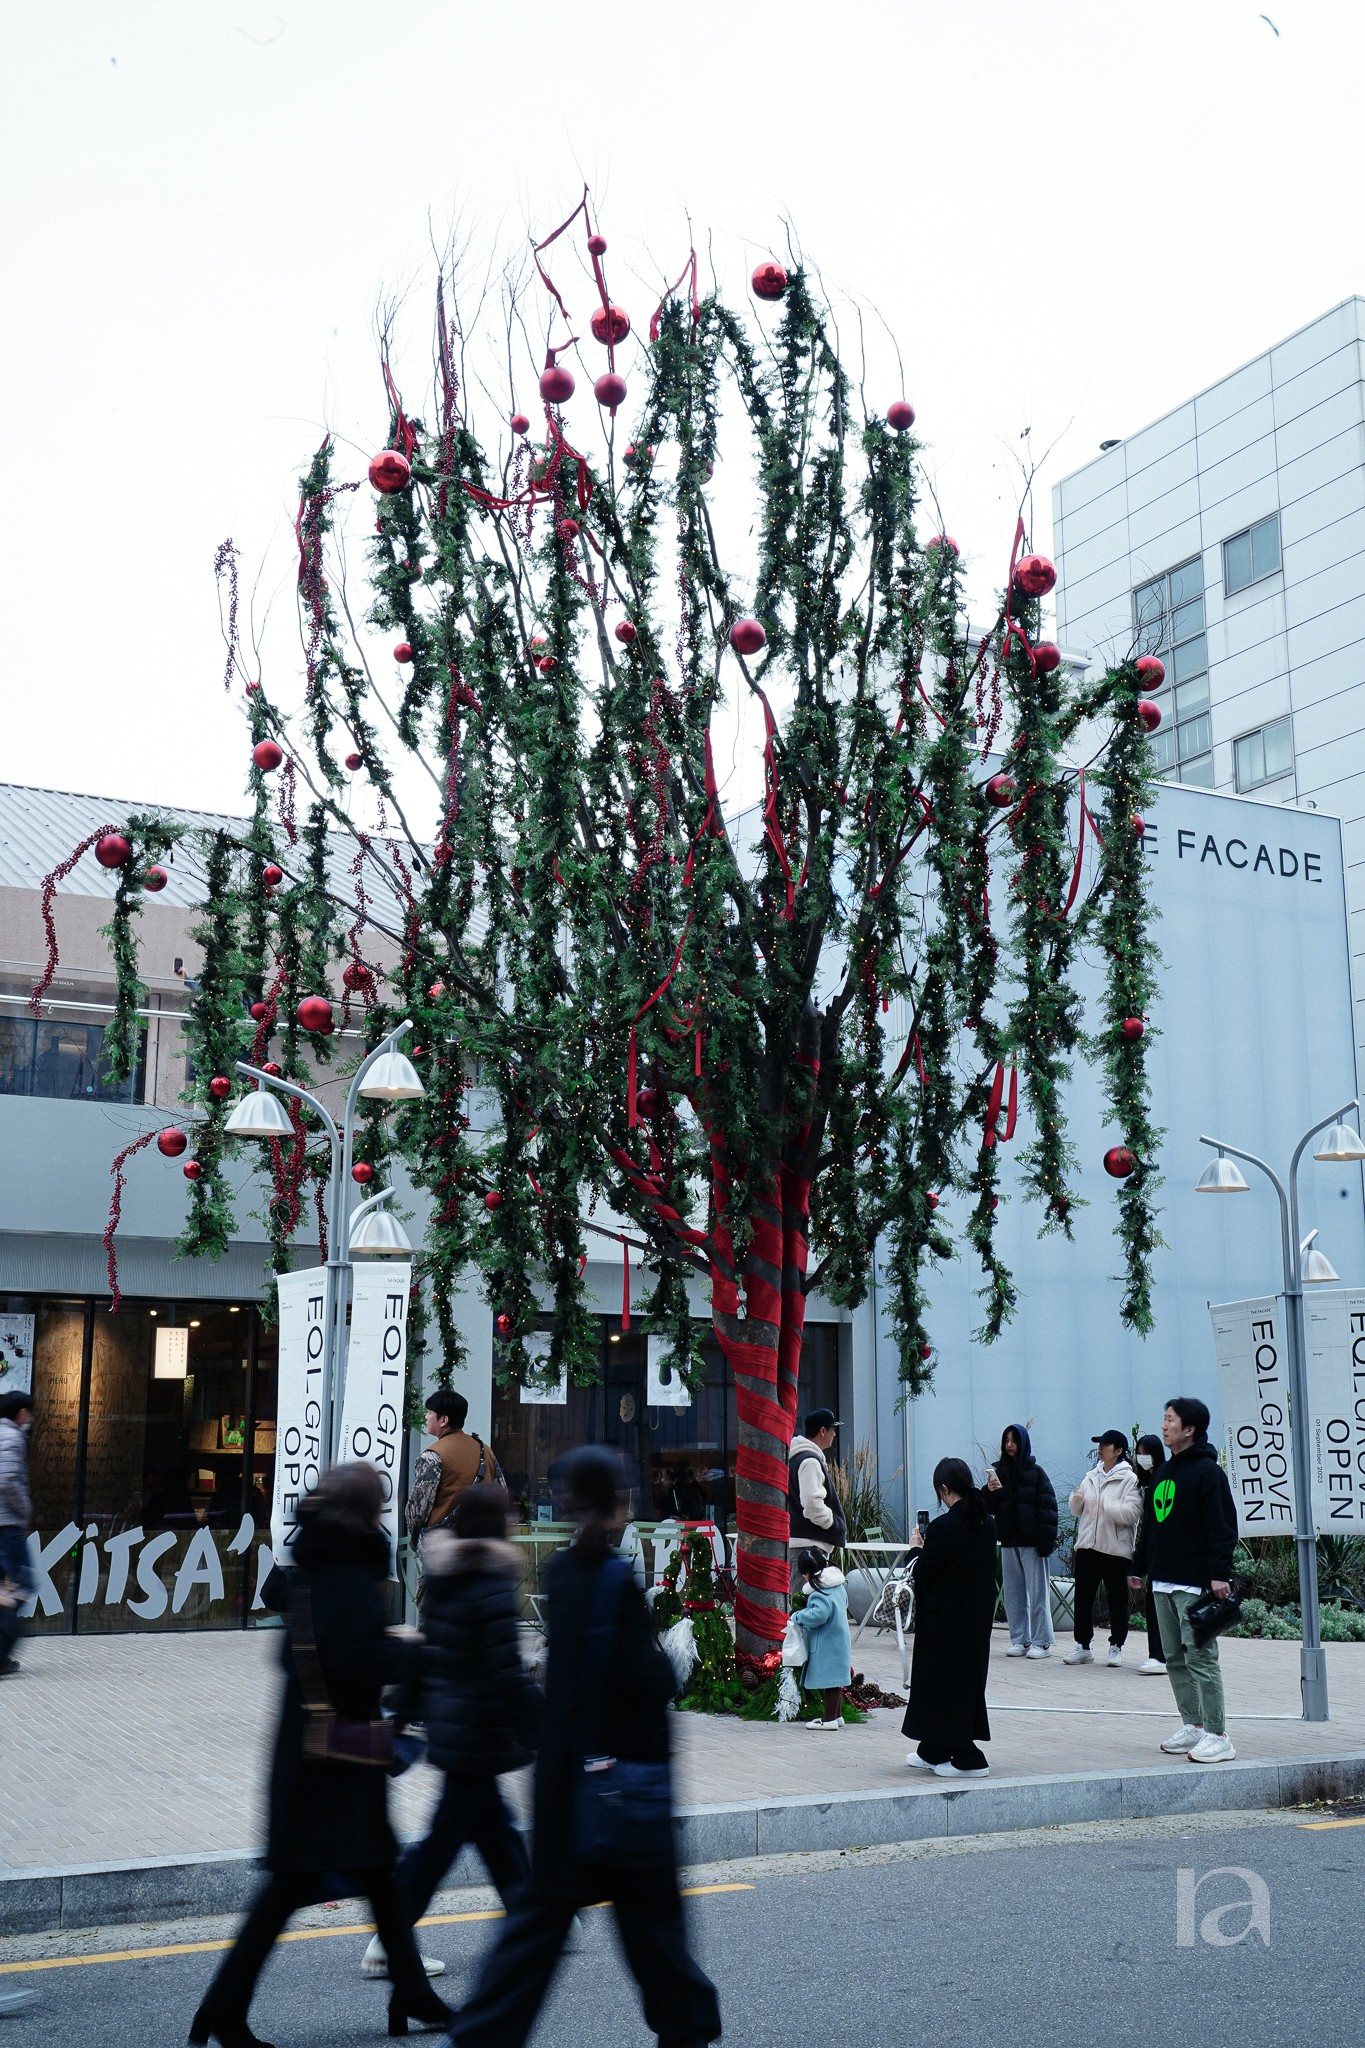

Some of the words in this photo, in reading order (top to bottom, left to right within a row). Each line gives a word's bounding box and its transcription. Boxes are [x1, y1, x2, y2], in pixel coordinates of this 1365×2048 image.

[1177, 829, 1323, 883] FACADE
[1228, 1436, 1236, 1471] September
[1315, 1418, 1321, 1426] 01
[283, 1426, 301, 1547] OPEN
[1236, 1425, 1266, 1521] OPEN
[1326, 1419, 1354, 1519] OPEN
